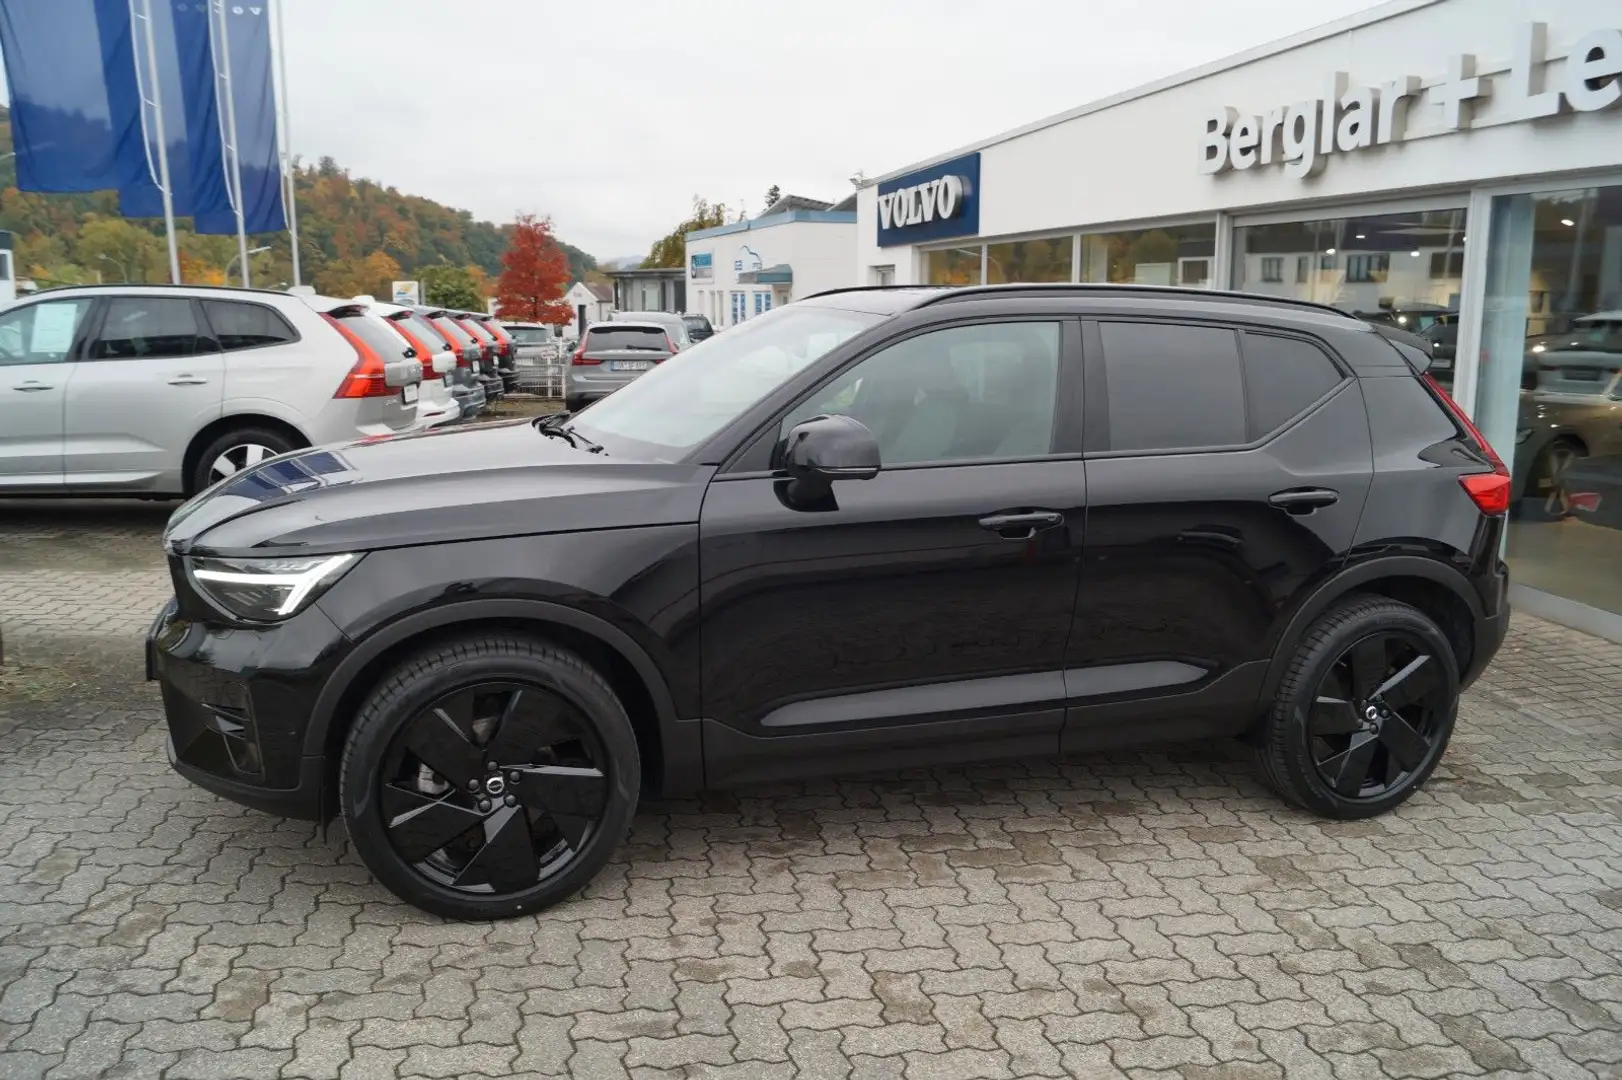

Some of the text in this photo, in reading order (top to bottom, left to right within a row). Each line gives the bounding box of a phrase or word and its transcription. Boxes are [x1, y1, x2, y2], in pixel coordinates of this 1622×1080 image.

[1200, 71, 1421, 178] Berglar
[1428, 54, 1492, 130] +
[878, 175, 963, 230] VOLVO
